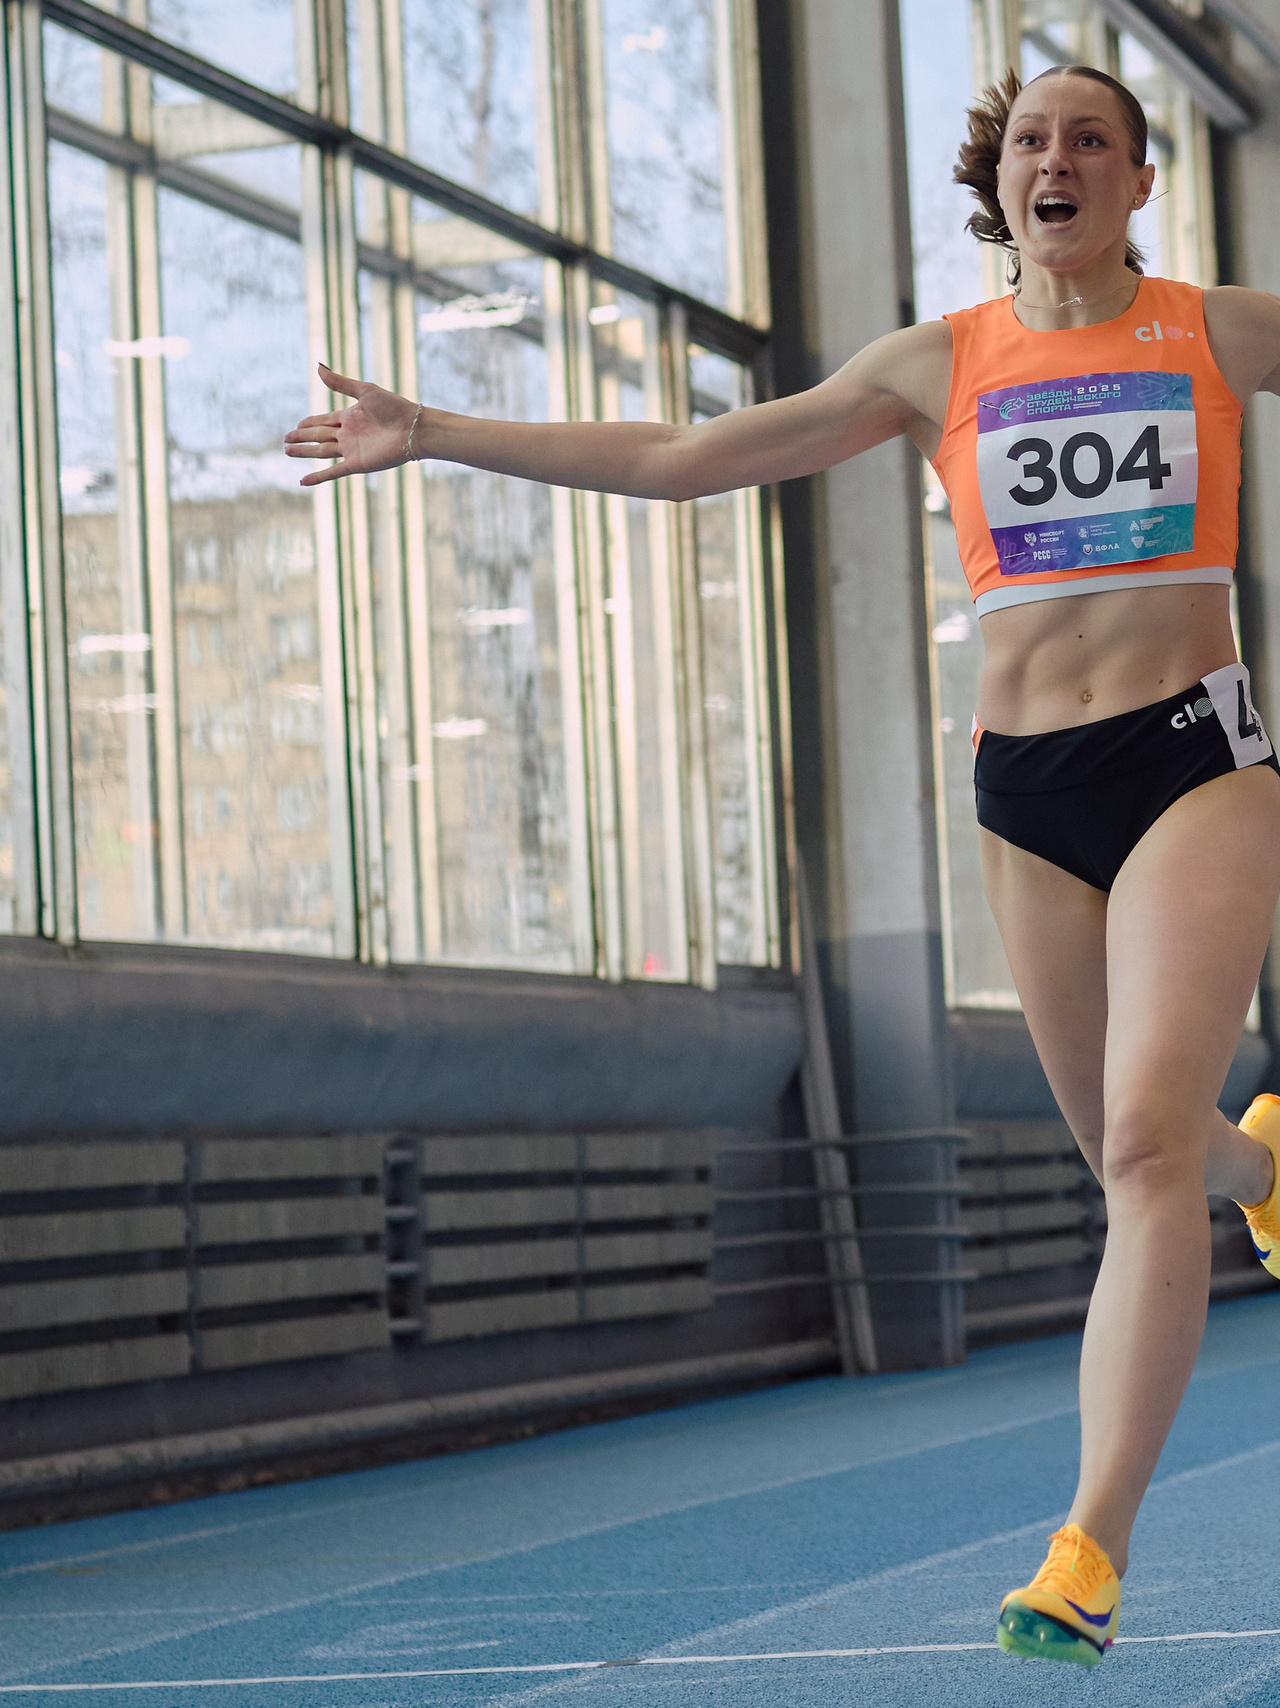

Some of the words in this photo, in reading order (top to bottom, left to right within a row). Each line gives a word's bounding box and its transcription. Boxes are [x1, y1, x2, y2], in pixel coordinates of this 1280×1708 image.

[1077, 383, 1121, 395] 2025
[1026, 391, 1121, 409] СТУДЕНЧЕСКОГО
[1026, 403, 1072, 416] СПОРТА
[1006, 425, 1172, 507] 304
[1095, 543, 1120, 552] ВФЛА
